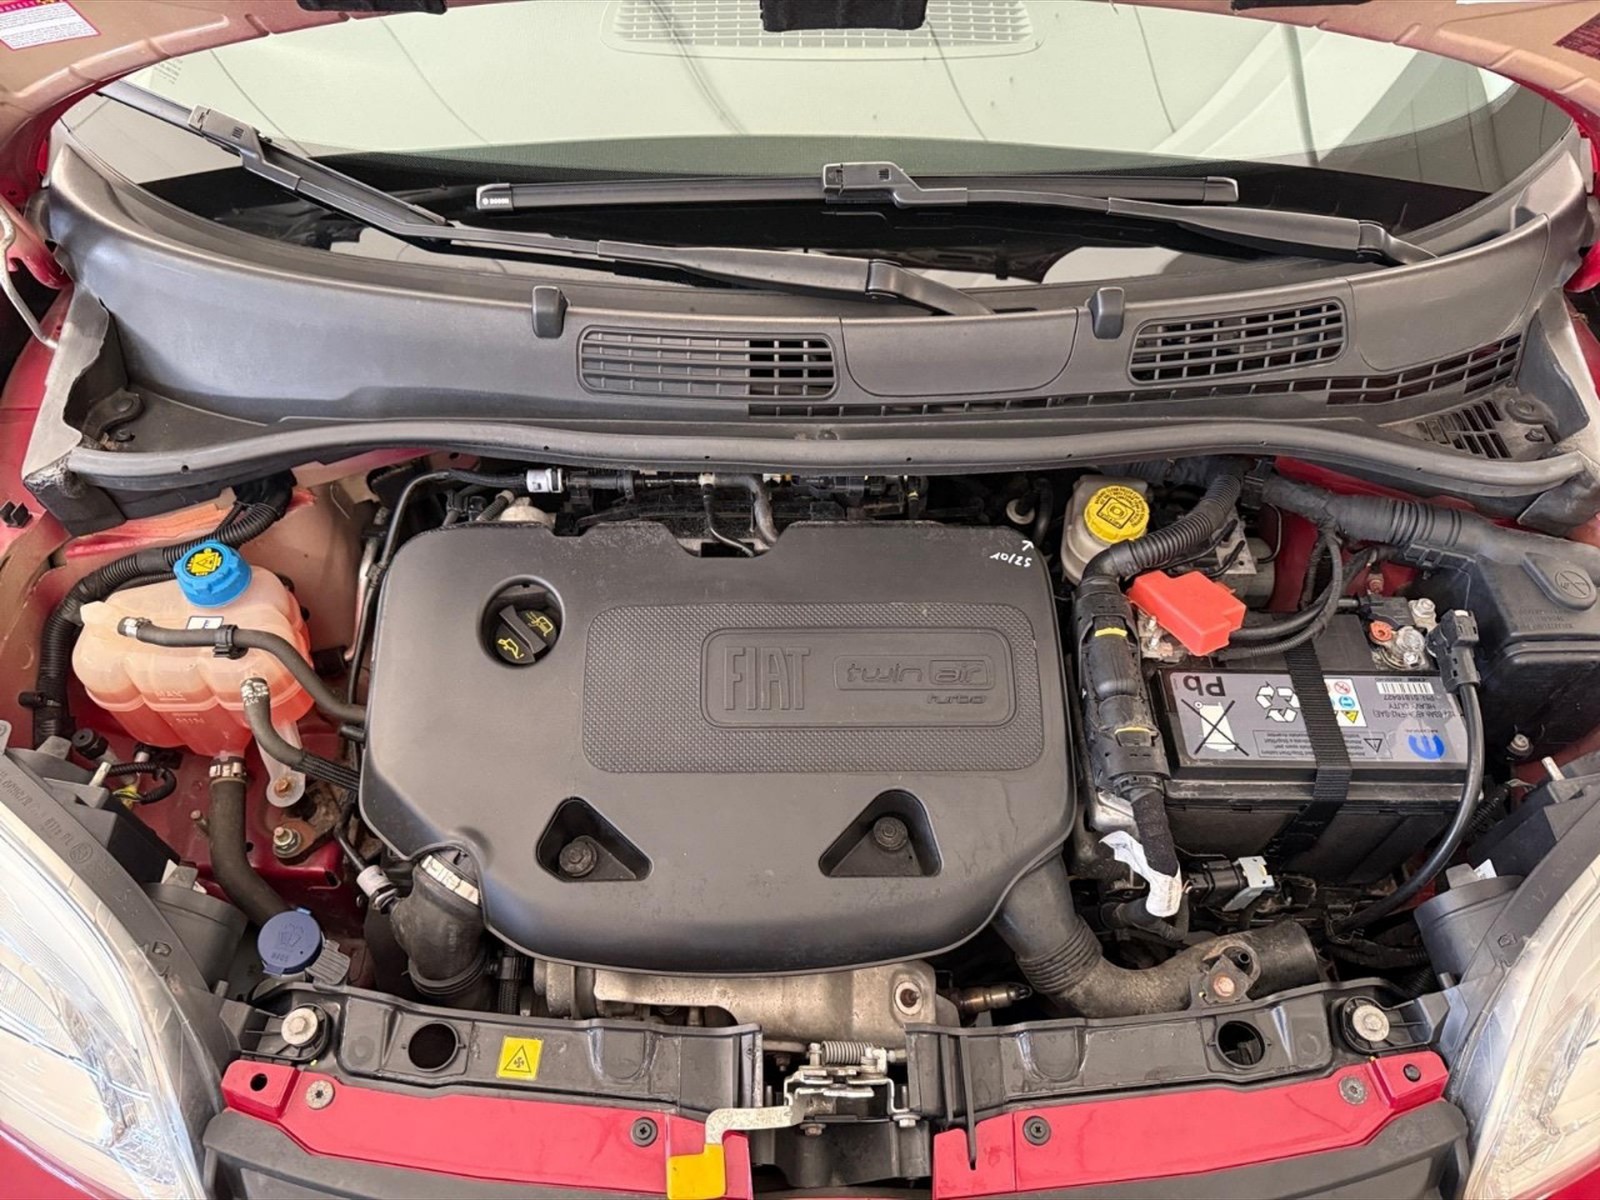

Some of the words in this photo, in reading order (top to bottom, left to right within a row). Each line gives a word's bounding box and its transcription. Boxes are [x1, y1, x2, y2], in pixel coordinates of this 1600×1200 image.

[724, 647, 811, 710] FIAT
[847, 663, 923, 683] twin
[935, 667, 983, 683] air
[1183, 675, 1226, 697] Pb
[927, 693, 988, 705] turbo
